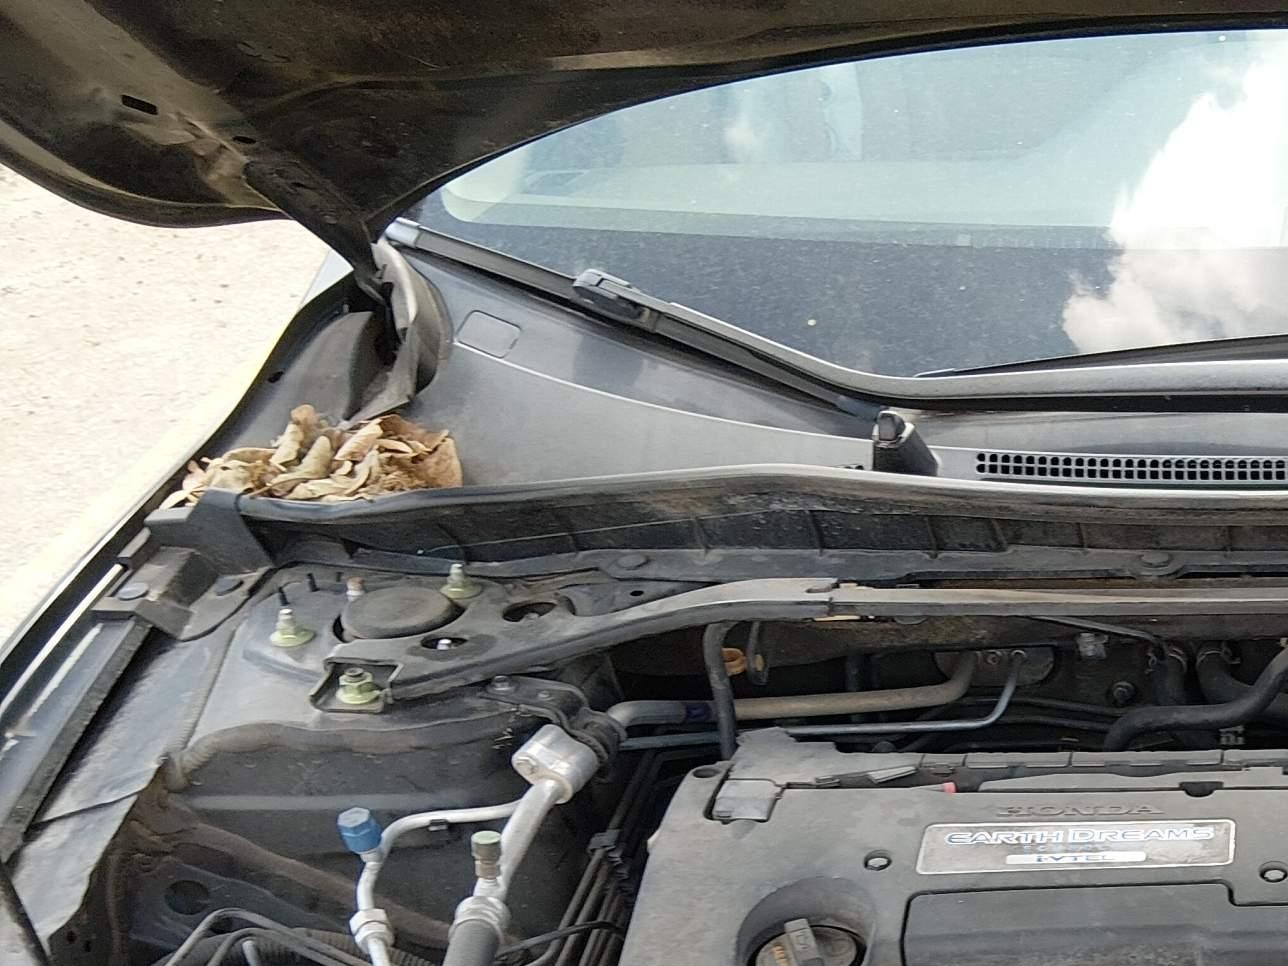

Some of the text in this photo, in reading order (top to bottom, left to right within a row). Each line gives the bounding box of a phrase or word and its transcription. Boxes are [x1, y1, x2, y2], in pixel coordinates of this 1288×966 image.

[999, 804, 1165, 818] HONDA
[945, 826, 1216, 846] EARTH DREAMS
